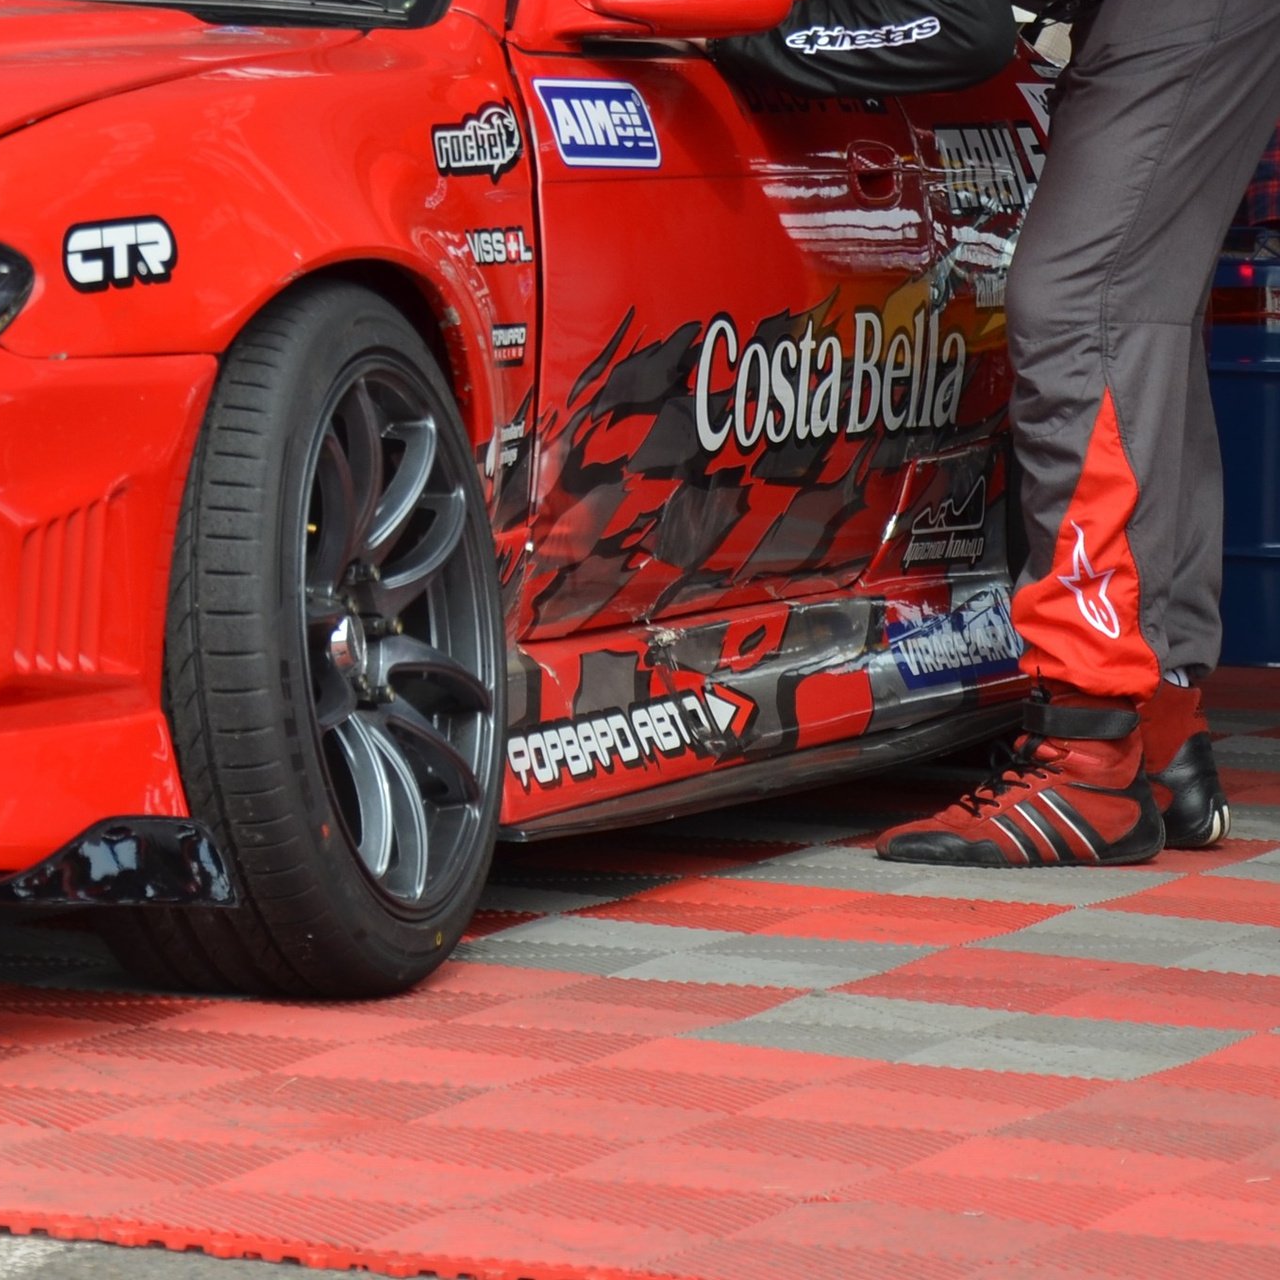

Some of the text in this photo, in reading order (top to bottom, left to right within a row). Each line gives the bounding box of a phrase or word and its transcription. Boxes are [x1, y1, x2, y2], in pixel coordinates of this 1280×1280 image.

[785, 15, 942, 55] alpinestars
[66, 221, 173, 284] CTR
[693, 311, 967, 454] Costa Bella
